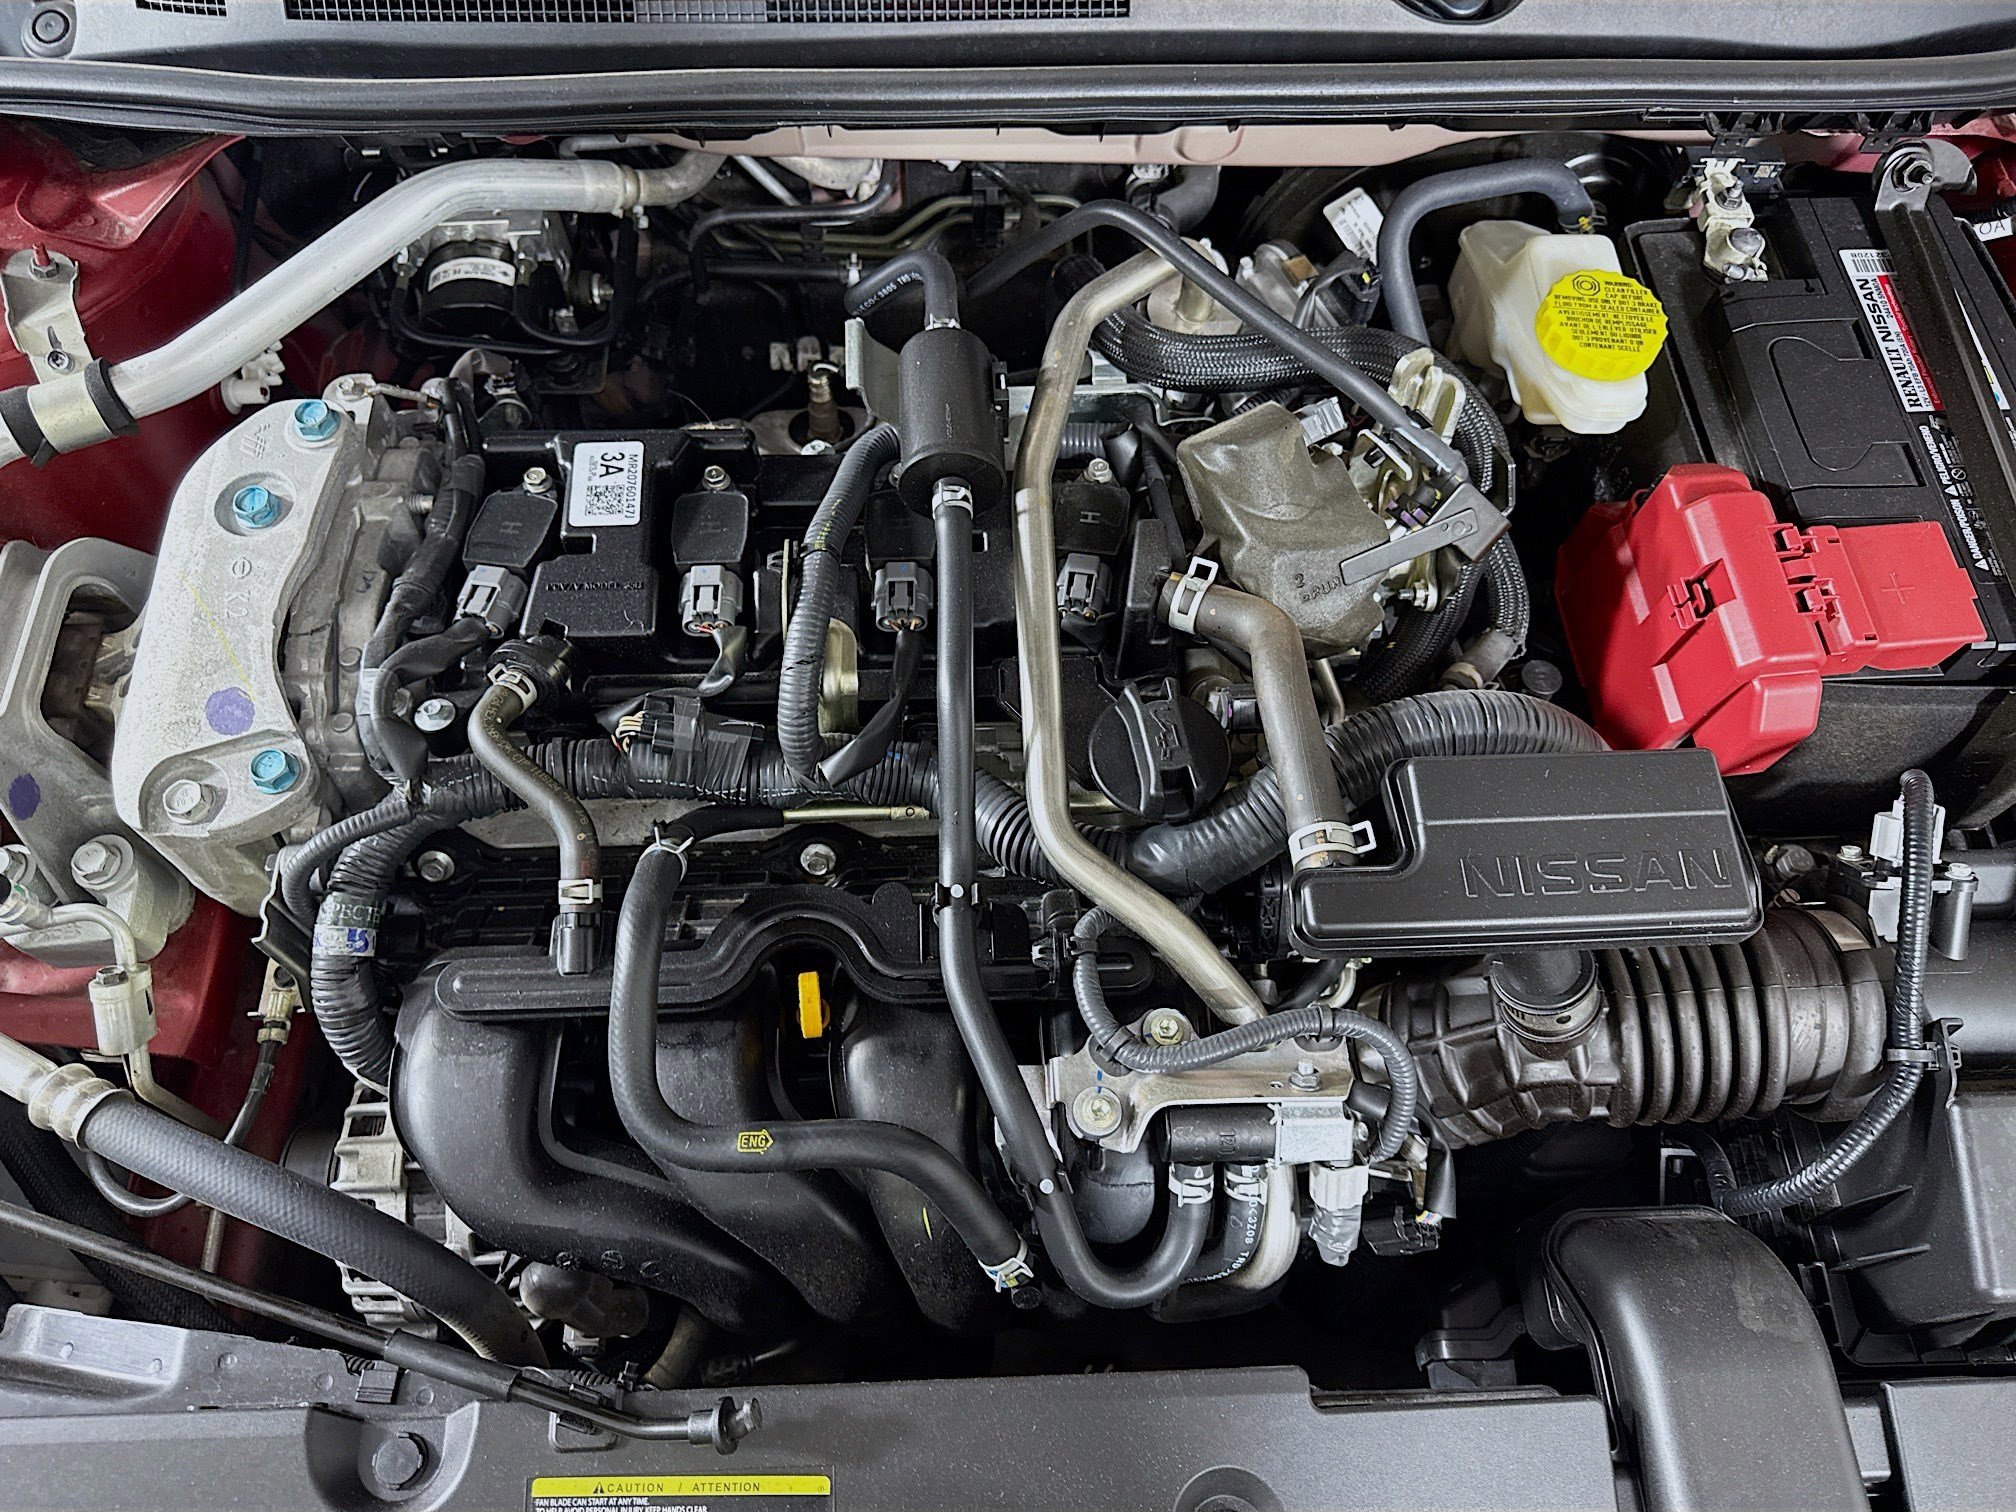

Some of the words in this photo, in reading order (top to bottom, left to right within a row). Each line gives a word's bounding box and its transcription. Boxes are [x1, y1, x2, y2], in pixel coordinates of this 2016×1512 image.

[1605, 319, 1647, 328] REMPLISSAGE
[1856, 278, 1894, 342] NISSAN
[1884, 347, 1924, 408] RENAULT
[600, 452, 625, 478] 3A
[1919, 426, 1952, 484] PELIGRO/VENENO
[1950, 499, 1983, 560] DANGER/POISON
[1460, 848, 1732, 898] NISSAN
[741, 1135, 766, 1148] ENG
[535, 1498, 549, 1506] FAN
[550, 1498, 571, 1506] BLADE
[572, 1498, 587, 1506] CAN
[588, 1498, 608, 1506] START
[608, 1498, 617, 1506] AT
[618, 1497, 632, 1505] ANY
[607, 1483, 664, 1492] CAUTION
[692, 1482, 760, 1492] ATTENTION
